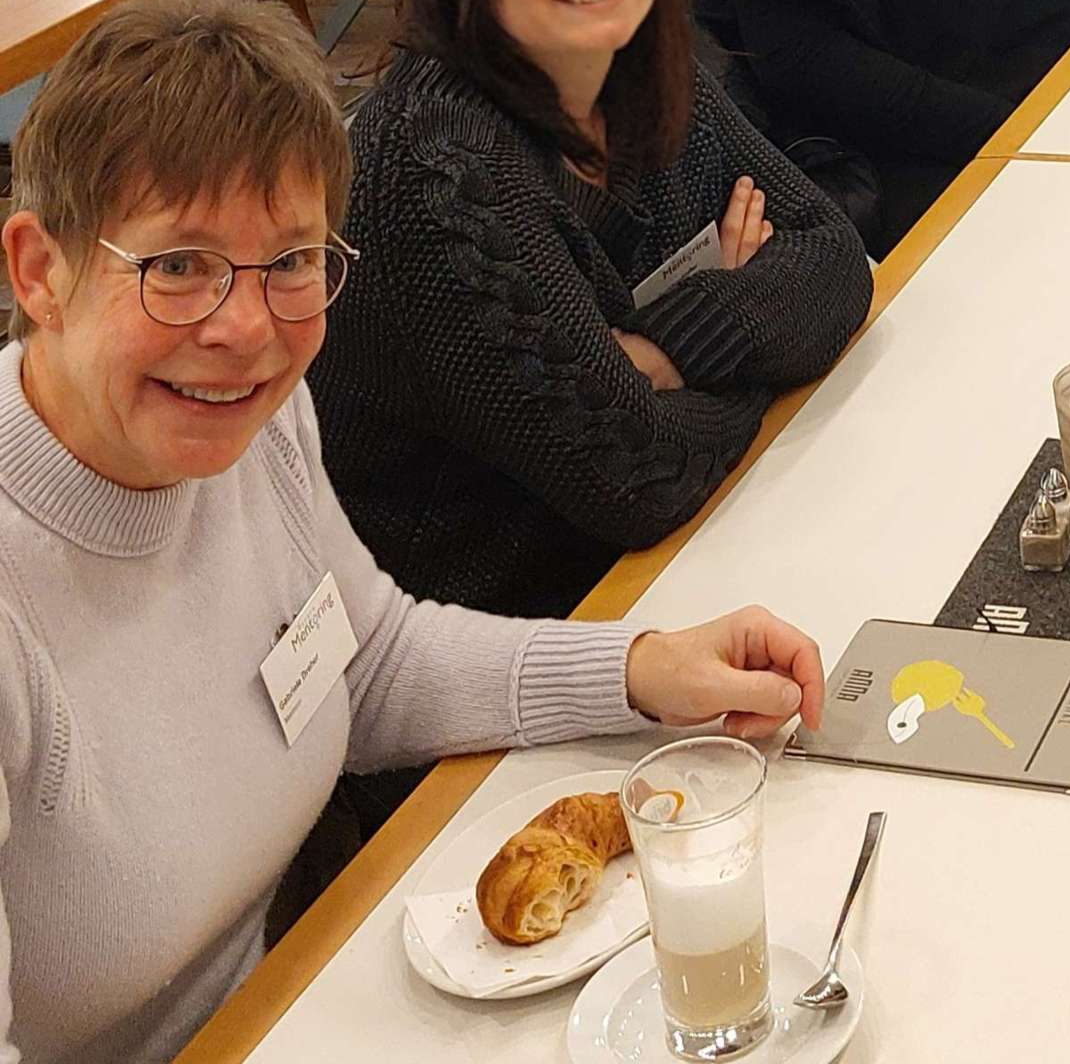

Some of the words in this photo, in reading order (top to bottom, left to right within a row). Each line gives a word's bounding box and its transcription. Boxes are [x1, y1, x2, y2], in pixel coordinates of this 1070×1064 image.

[290, 593, 335, 653] Mentoring
[972, 604, 1030, 634] AN
[836, 668, 874, 702] ANNA
